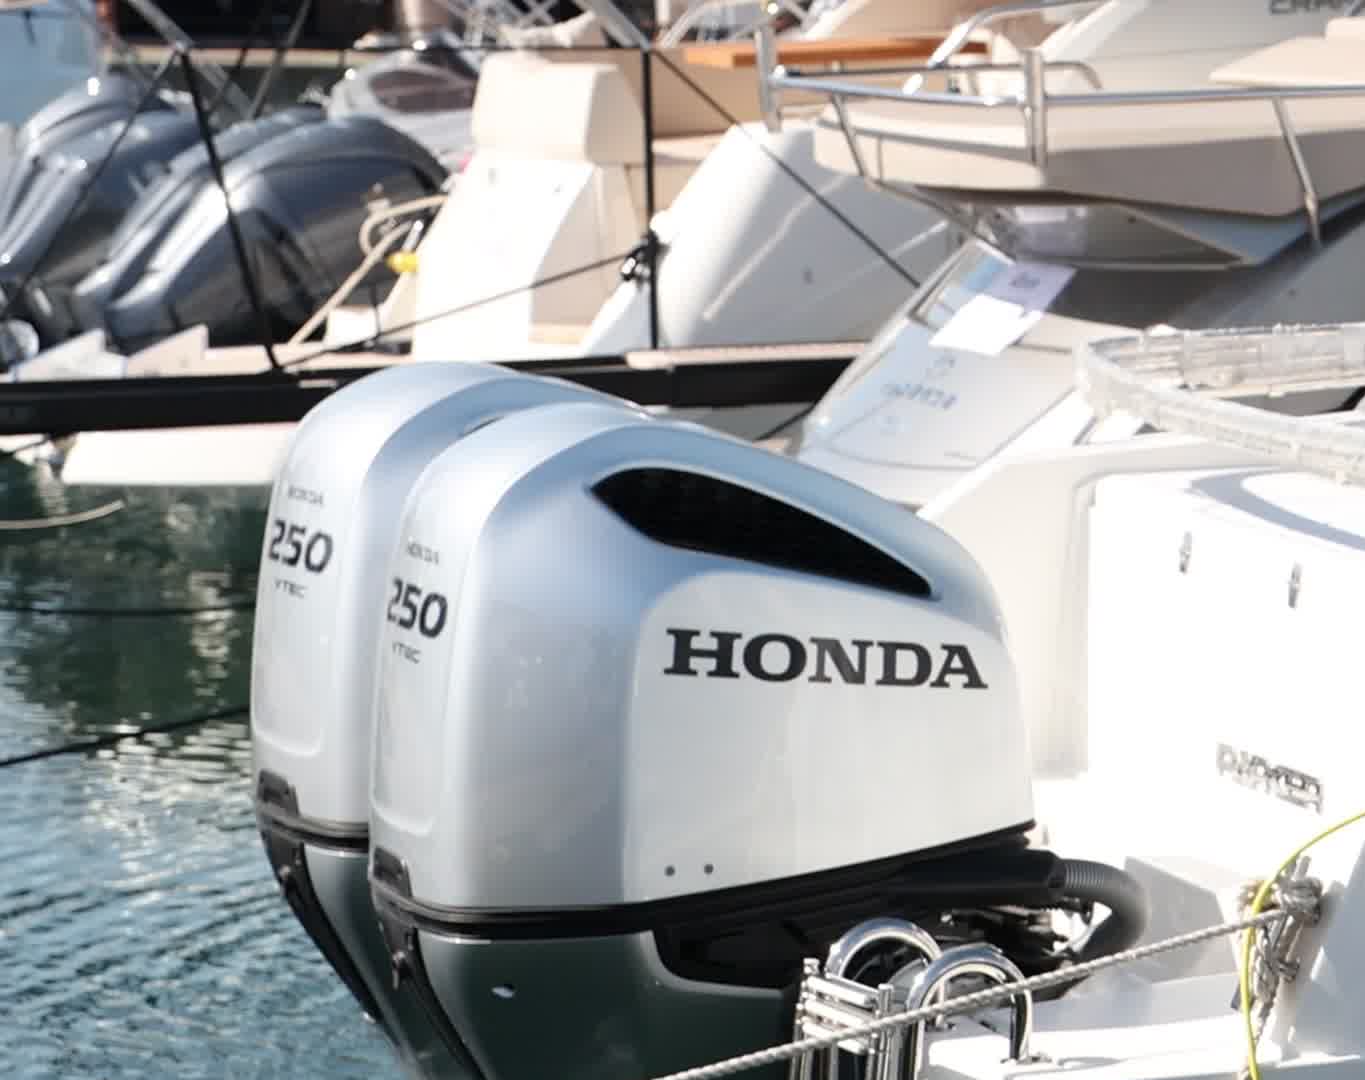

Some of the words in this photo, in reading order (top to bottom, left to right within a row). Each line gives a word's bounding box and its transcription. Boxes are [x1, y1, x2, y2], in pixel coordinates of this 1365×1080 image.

[268, 516, 334, 575] 250
[386, 576, 449, 640] 250
[663, 627, 989, 690] HONDA
